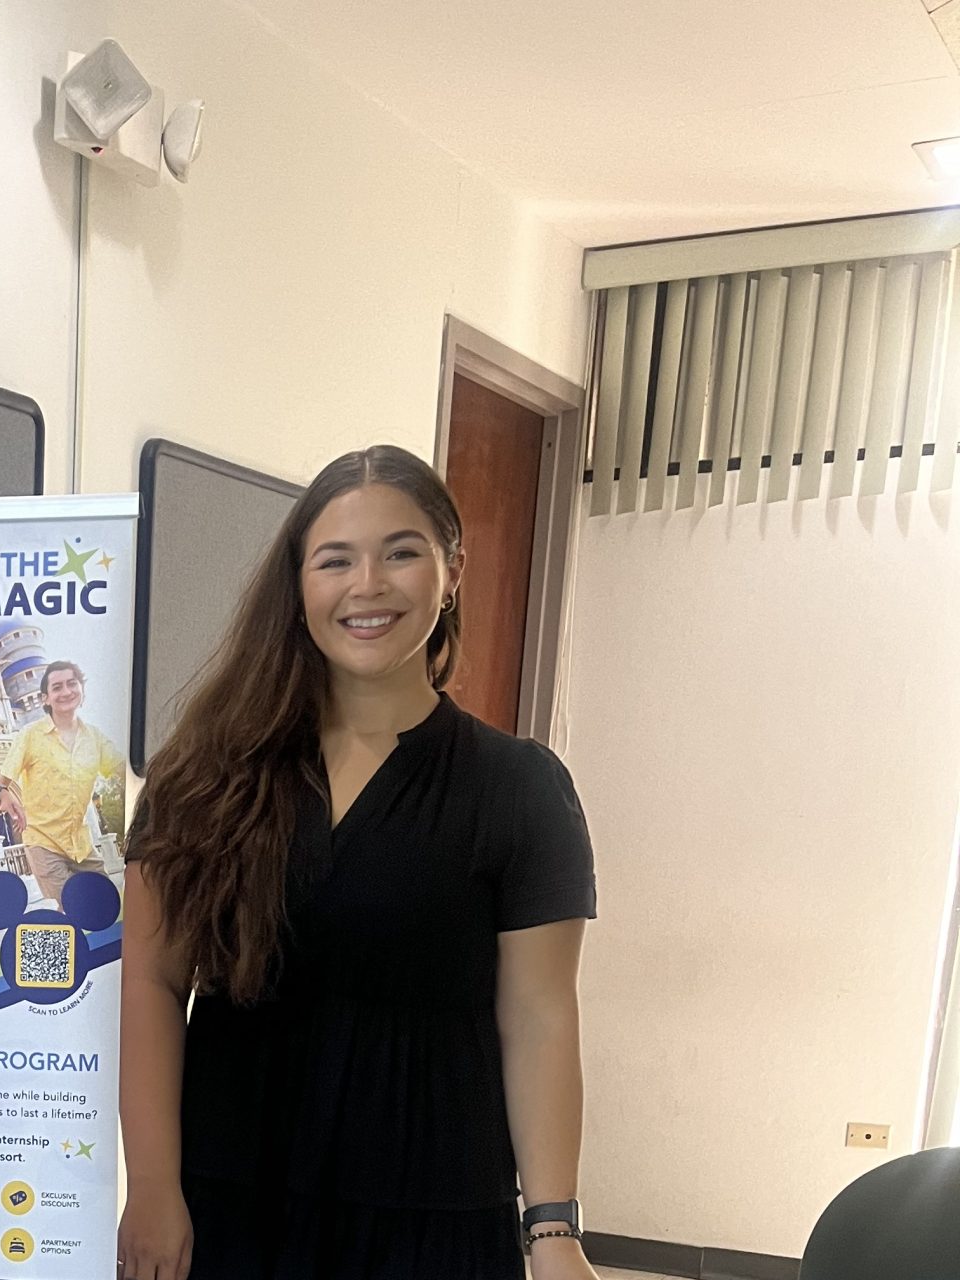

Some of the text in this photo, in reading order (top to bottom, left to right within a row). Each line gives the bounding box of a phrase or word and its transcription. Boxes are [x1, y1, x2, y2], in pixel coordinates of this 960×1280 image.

[0, 551, 59, 577] THE
[28, 1005, 47, 1016] SCAN
[59, 999, 81, 1014] LEARN
[79, 980, 94, 1001] MORE
[12, 1089, 40, 1101] while
[43, 1091, 87, 1105] building
[6, 1109, 18, 1117] to
[20, 1107, 39, 1118] last
[51, 1109, 98, 1120] lifetime?
[41, 1192, 77, 1200] EXCLUSIVE
[40, 1200, 80, 1208] DISCOUNTS
[41, 1239, 82, 1247] APARTMENT
[40, 1247, 71, 1255] OPTIONS
